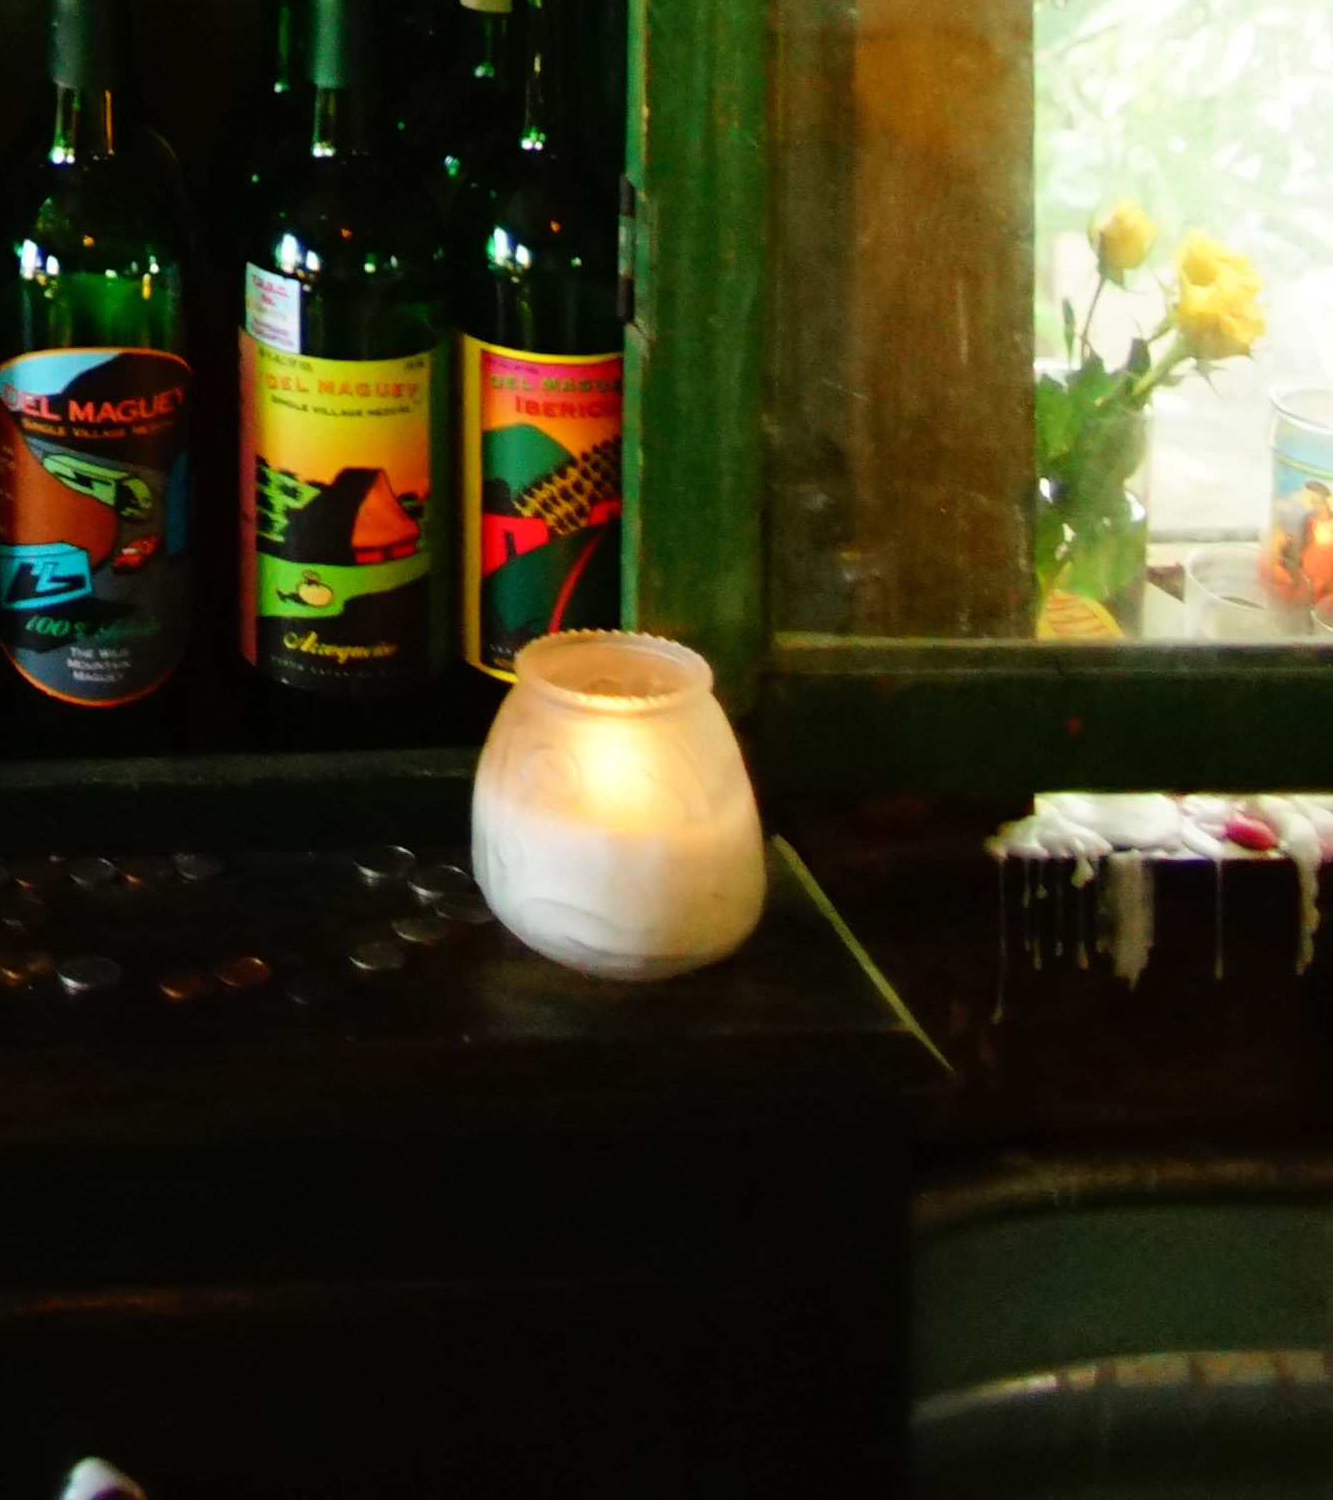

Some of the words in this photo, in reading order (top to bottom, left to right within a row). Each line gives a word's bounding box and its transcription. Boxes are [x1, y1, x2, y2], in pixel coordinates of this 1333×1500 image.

[265, 374, 309, 393] DEL
[317, 380, 418, 397] MAGUEY
[2, 382, 61, 421] DEL
[68, 385, 183, 423] MAGUEY
